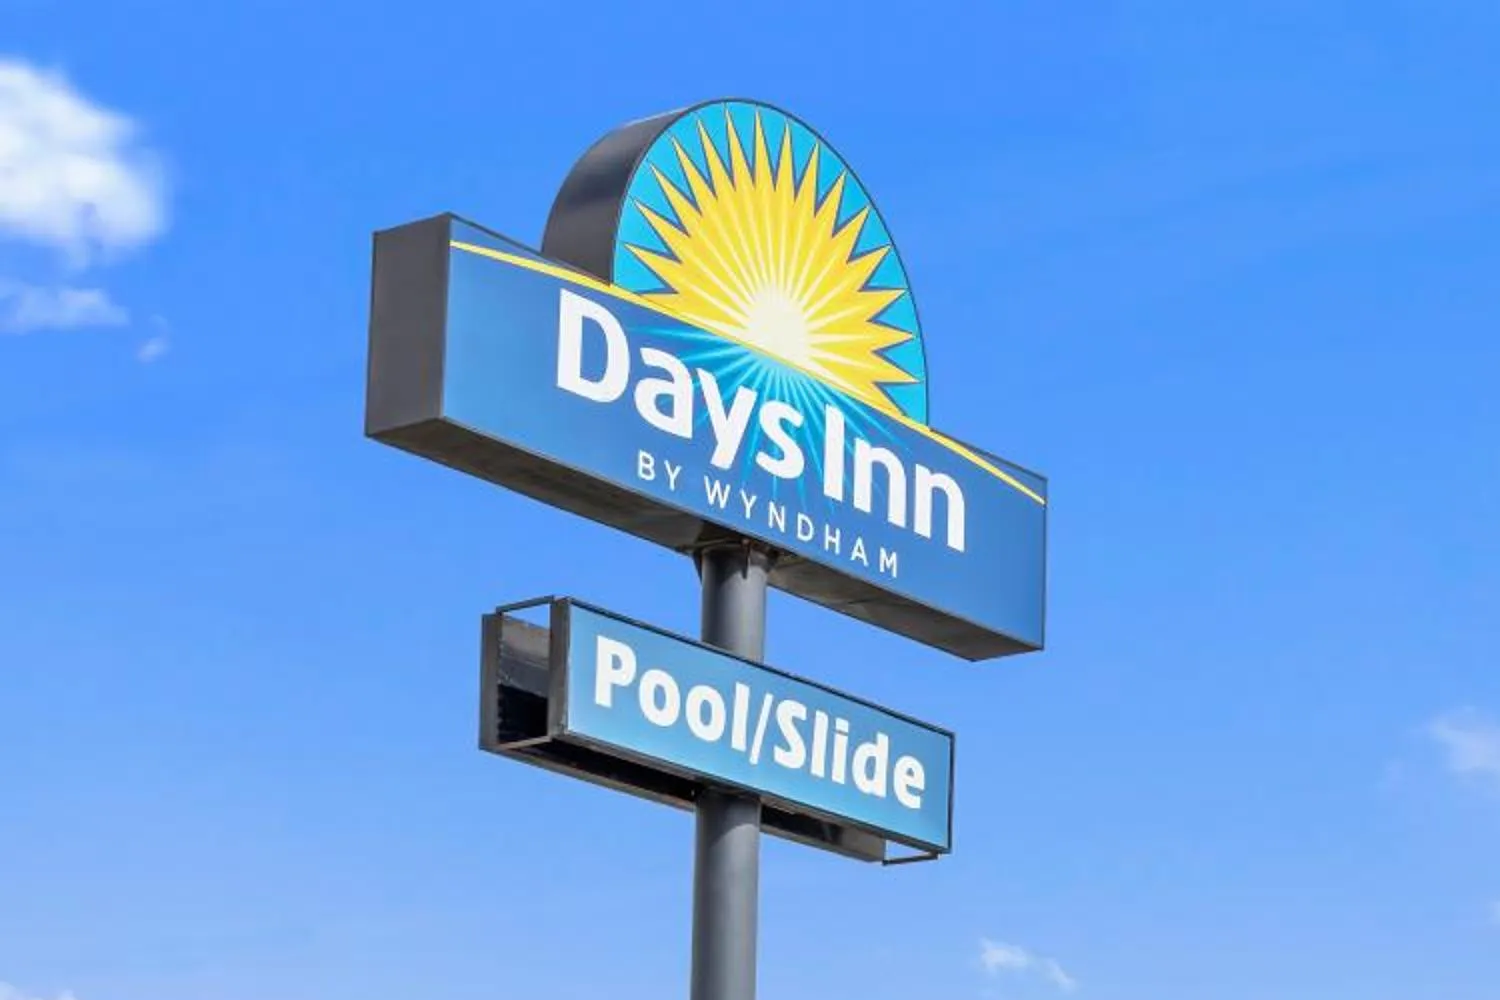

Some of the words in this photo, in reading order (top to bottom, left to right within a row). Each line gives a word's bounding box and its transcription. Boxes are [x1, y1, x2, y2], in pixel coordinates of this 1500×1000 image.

[556, 288, 805, 479] Days
[823, 404, 965, 553] Inn
[637, 450, 682, 492] BY
[704, 475, 899, 579] WYNDHAM
[594, 635, 926, 810] Pool/Slide
